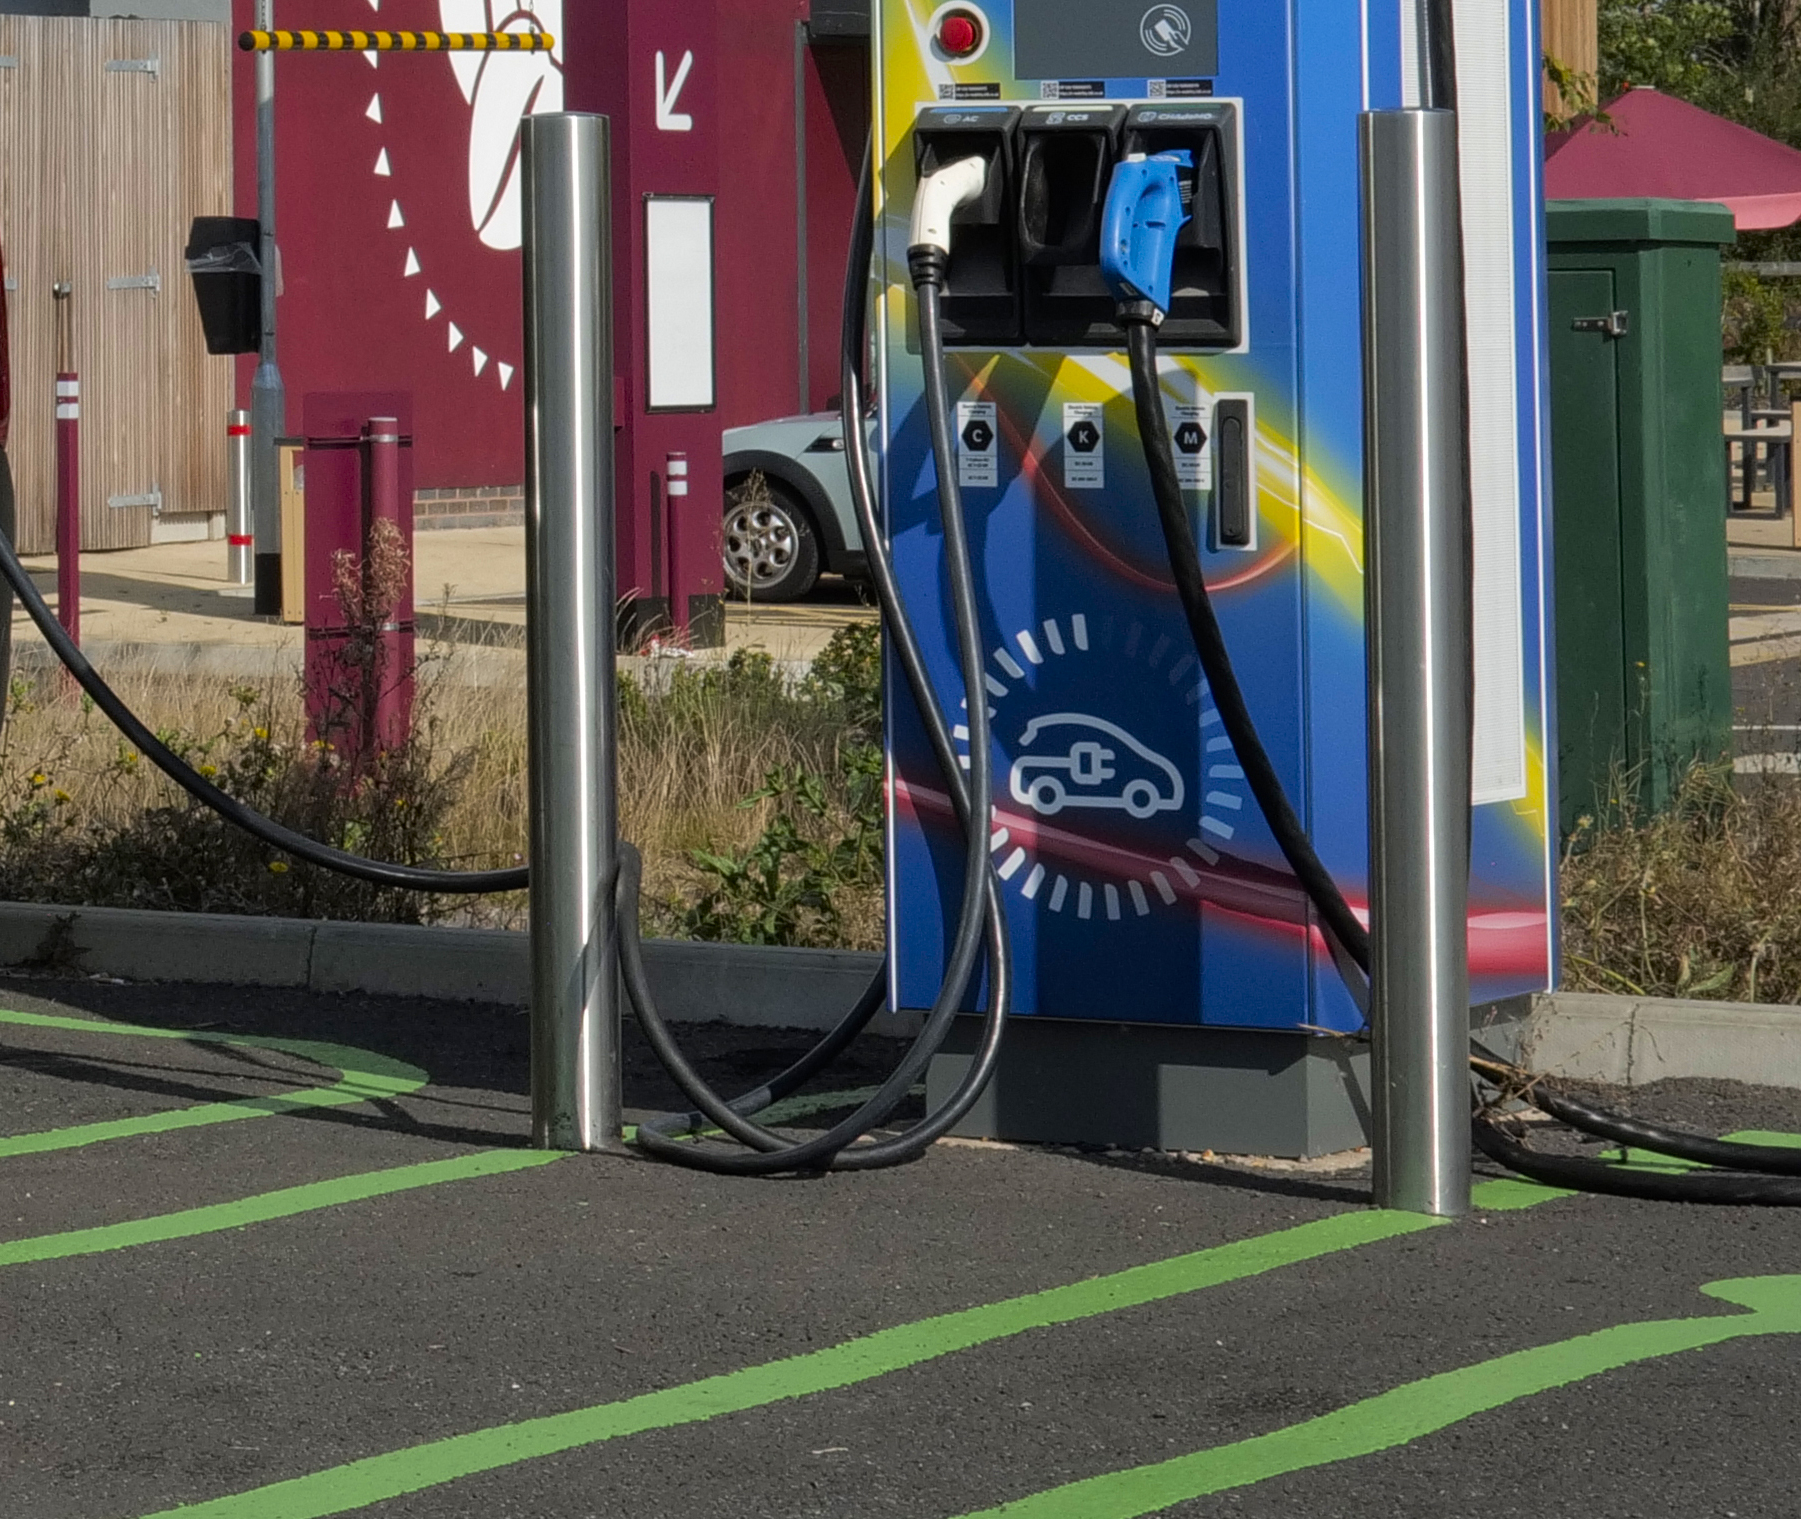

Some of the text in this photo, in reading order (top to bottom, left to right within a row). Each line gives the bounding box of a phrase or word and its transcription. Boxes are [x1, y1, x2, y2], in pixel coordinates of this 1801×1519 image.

[961, 115, 979, 123] AC
[1067, 113, 1088, 122] CCS
[972, 430, 983, 443] C
[1079, 431, 1089, 443] K
[1183, 432, 1198, 444] M
